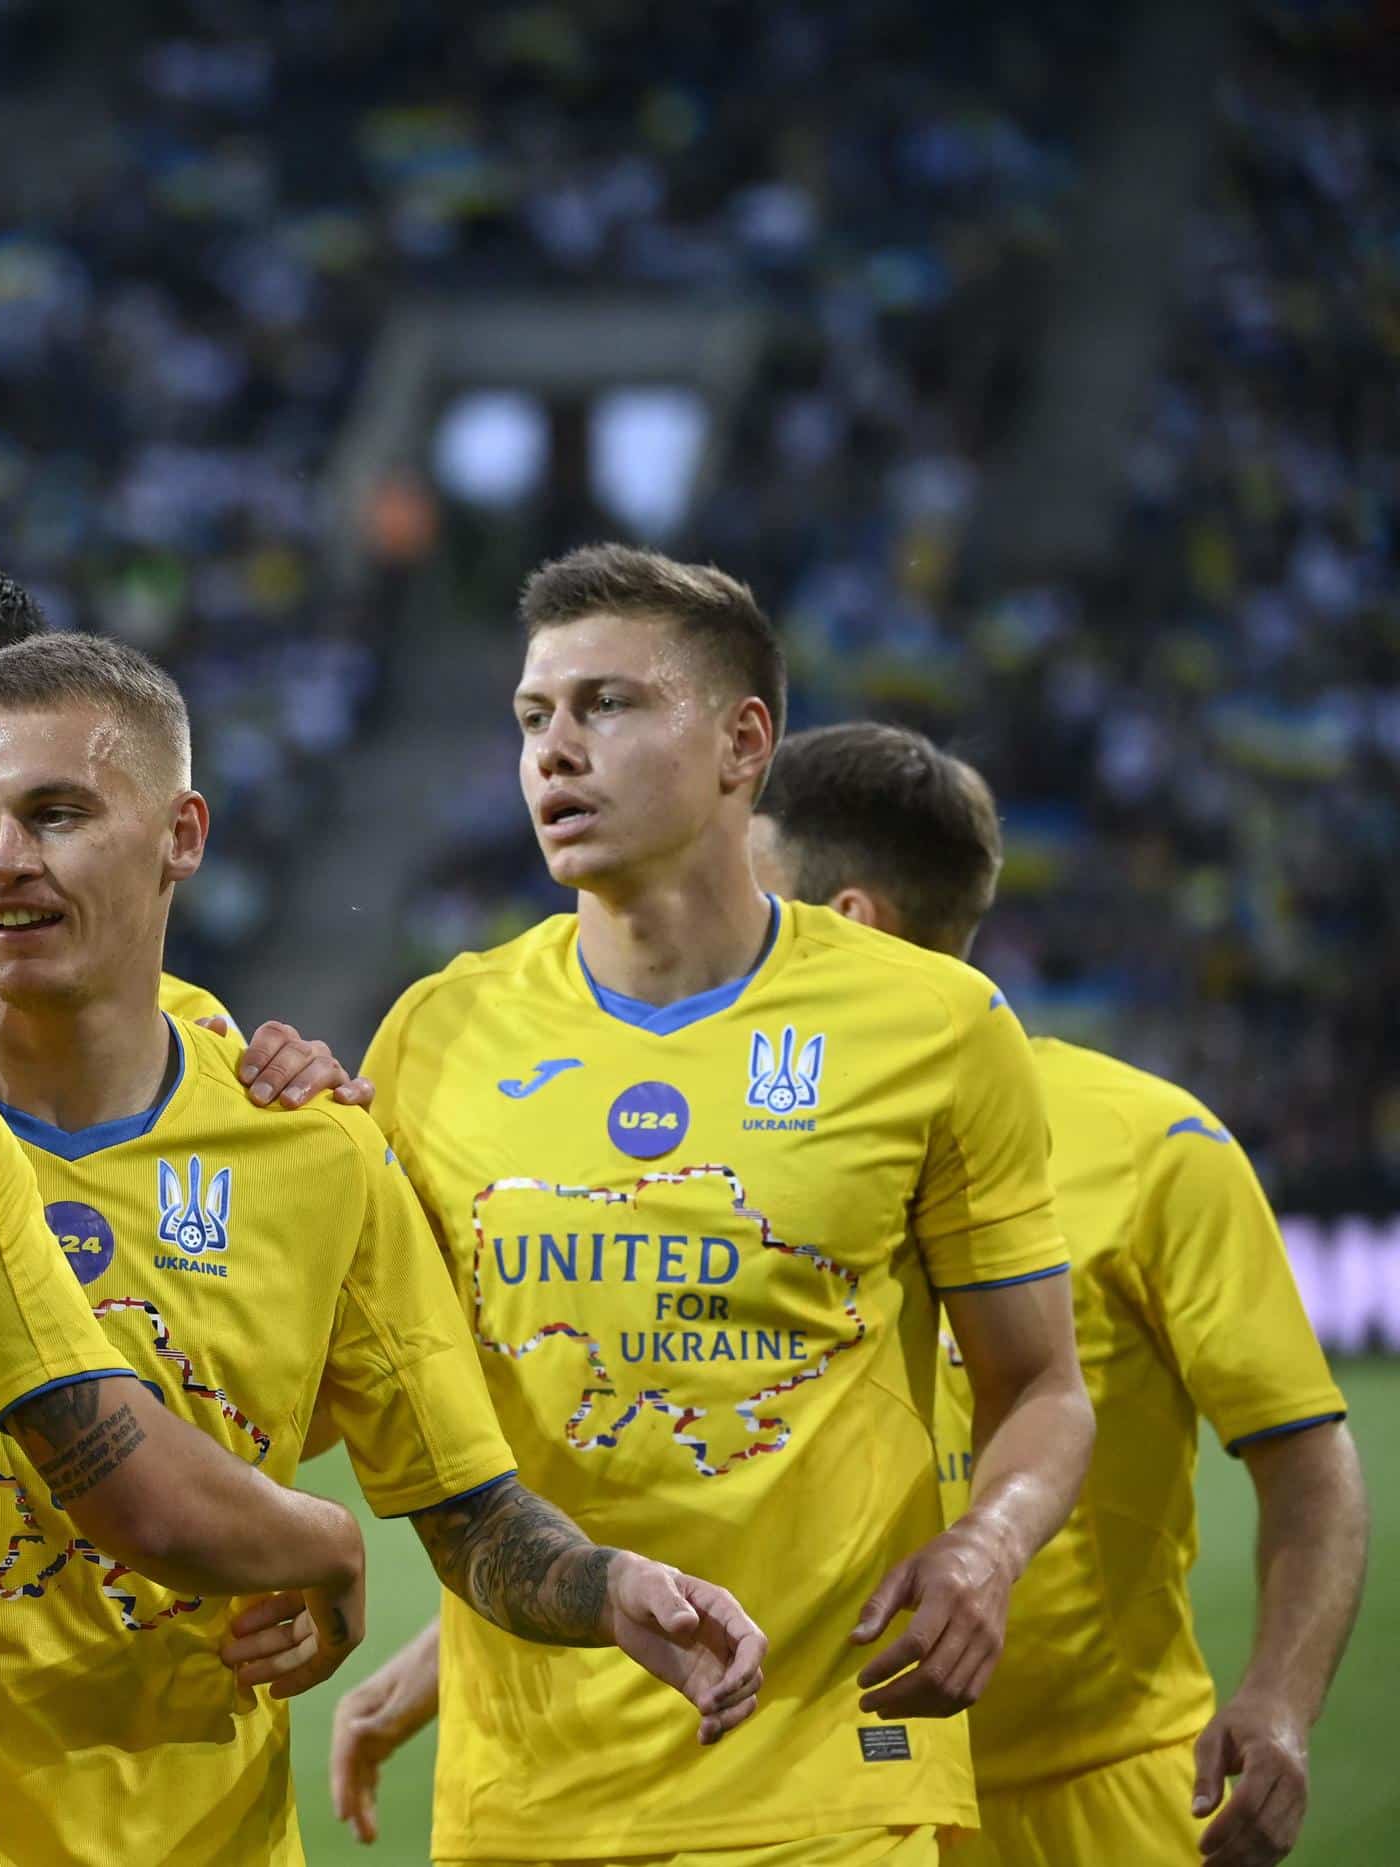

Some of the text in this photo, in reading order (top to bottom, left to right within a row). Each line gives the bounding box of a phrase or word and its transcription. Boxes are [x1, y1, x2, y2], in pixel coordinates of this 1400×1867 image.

[618, 1111, 678, 1130] U24
[743, 1118, 816, 1132] UKRAINE
[58, 1234, 102, 1254] 24
[154, 1255, 228, 1277] UKRAINE
[493, 1233, 740, 1285] UNITED
[655, 1292, 729, 1321] FOR
[620, 1330, 808, 1363] UKRAINE
